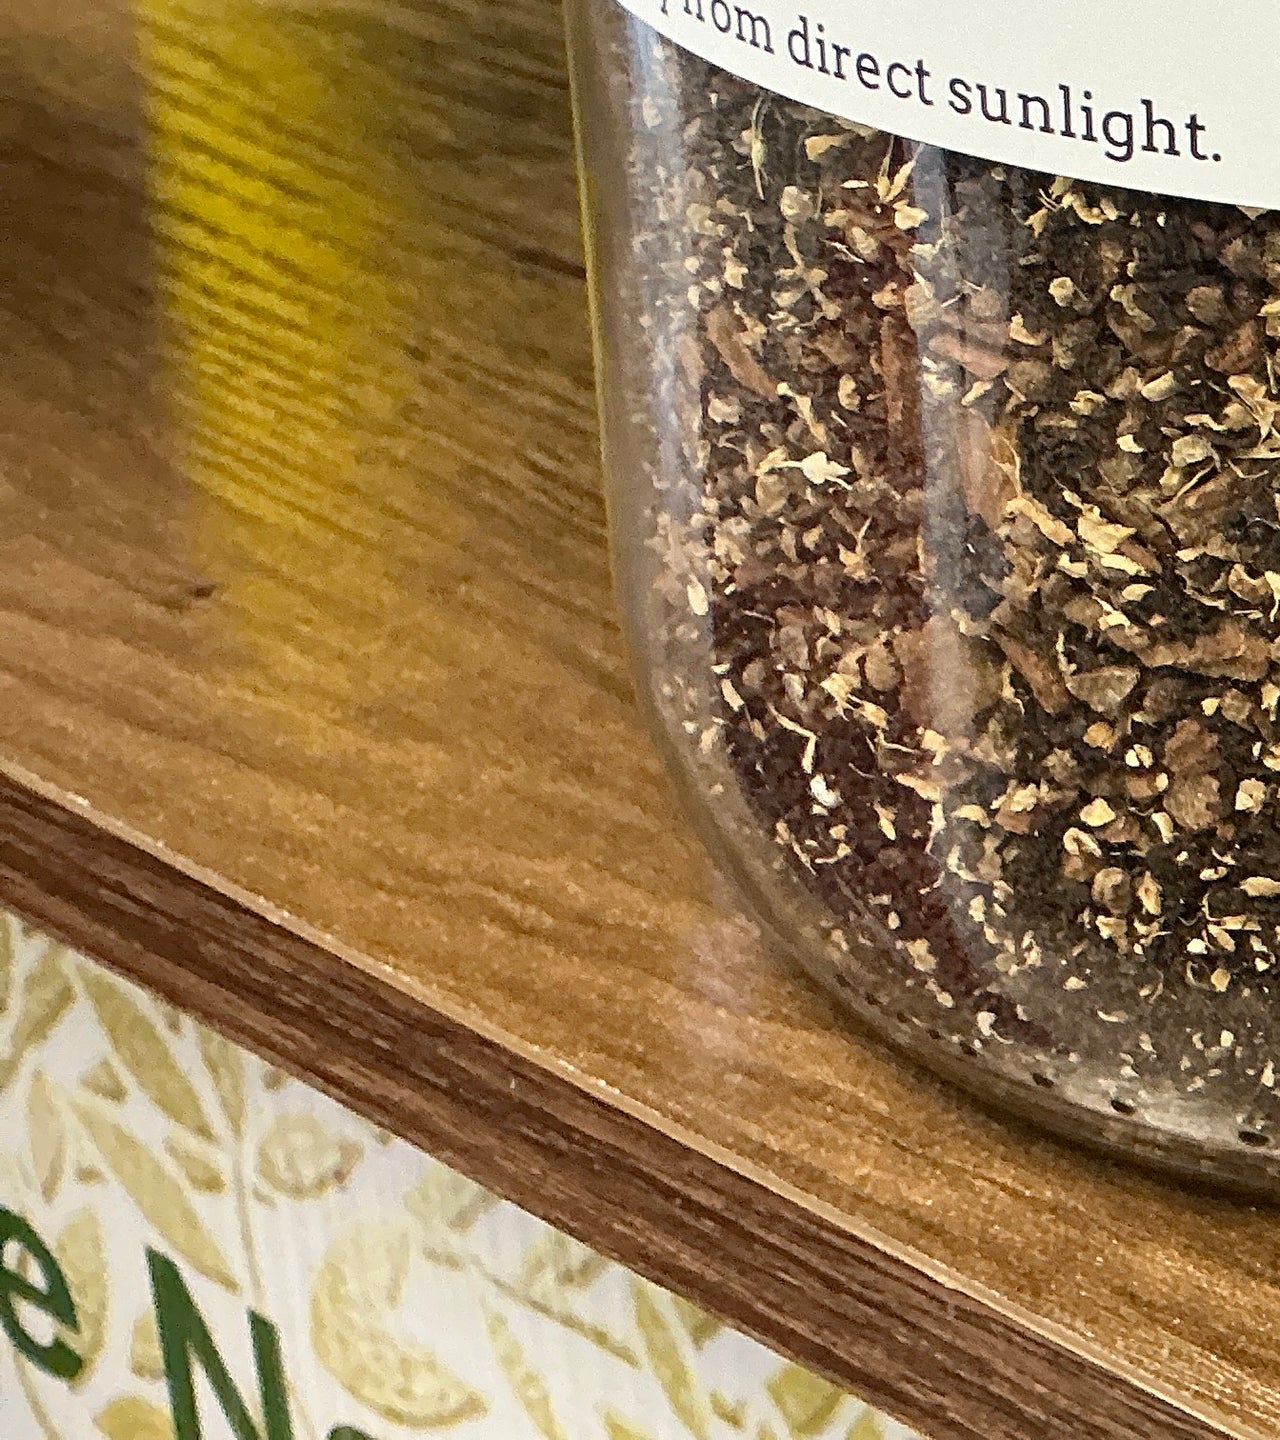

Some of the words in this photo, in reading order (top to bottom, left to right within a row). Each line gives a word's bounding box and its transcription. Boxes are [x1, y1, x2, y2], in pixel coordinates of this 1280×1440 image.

[787, 14, 935, 107] direct
[948, 77, 1222, 164] sunlight.
[146, 1243, 372, 1440] N
